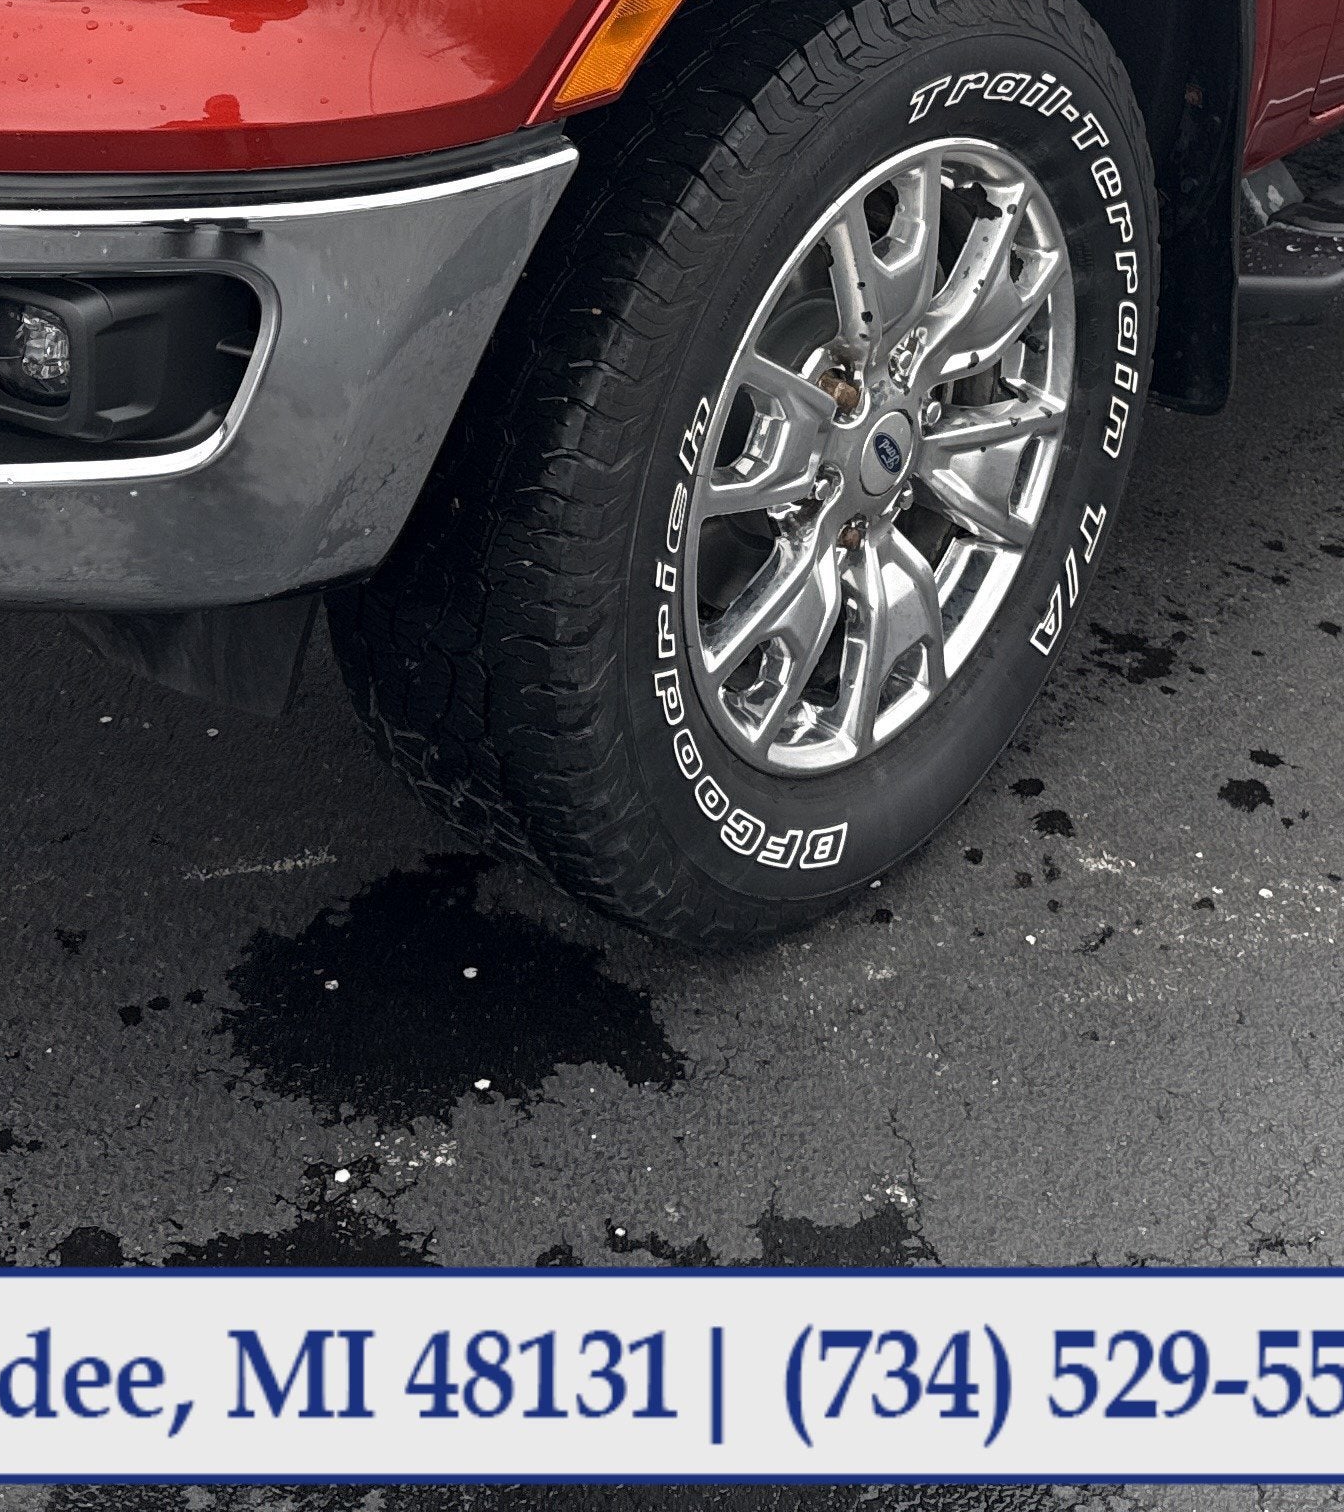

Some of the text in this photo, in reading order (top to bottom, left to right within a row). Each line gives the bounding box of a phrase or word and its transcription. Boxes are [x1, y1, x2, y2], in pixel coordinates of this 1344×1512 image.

[654, 71, 1139, 869] BFGoodrich Trail-Terrain T/A
[877, 438, 900, 470] Ford
